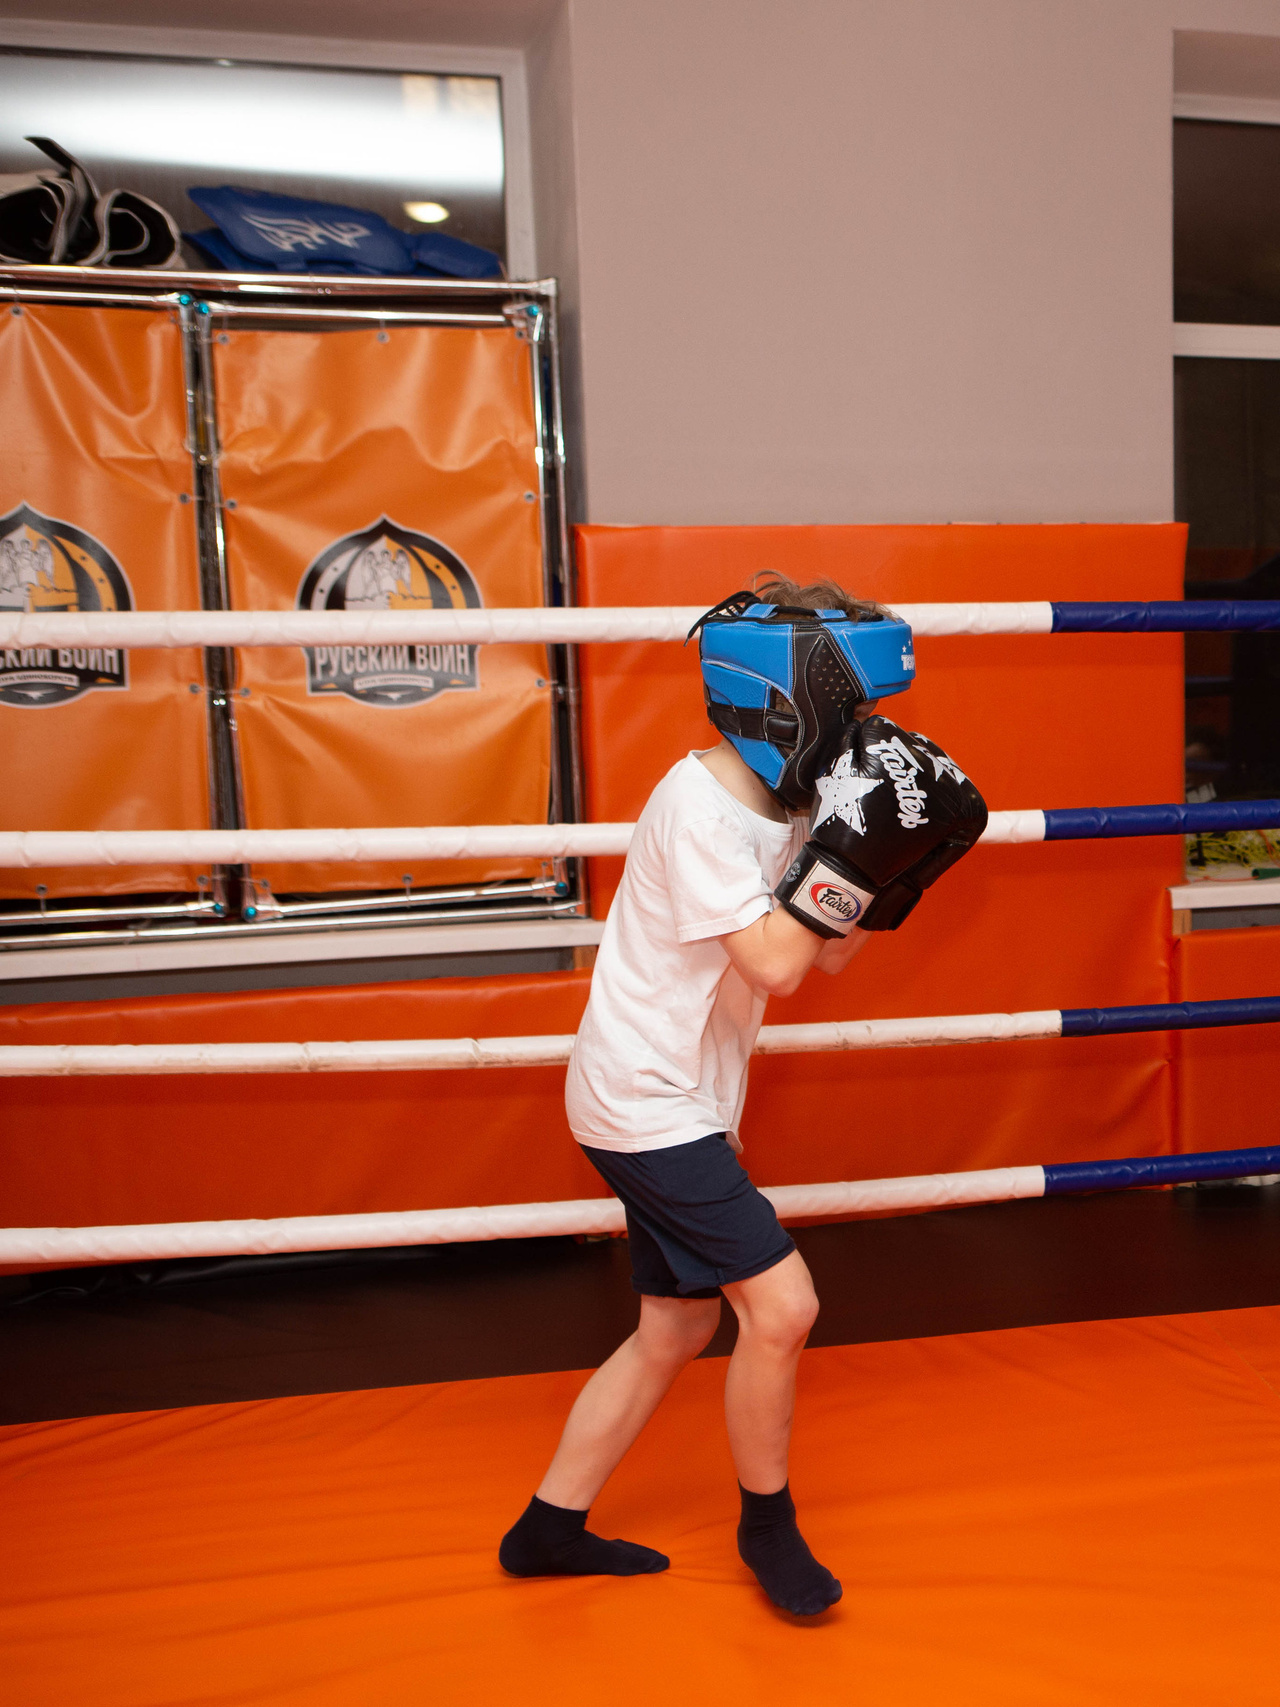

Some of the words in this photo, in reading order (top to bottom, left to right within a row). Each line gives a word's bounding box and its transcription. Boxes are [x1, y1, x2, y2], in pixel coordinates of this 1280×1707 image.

[58, 648, 120, 675] ВОИН
[415, 645, 470, 676] ВОИН
[865, 735, 930, 829] Fairtex
[819, 887, 857, 918] Fairtex
